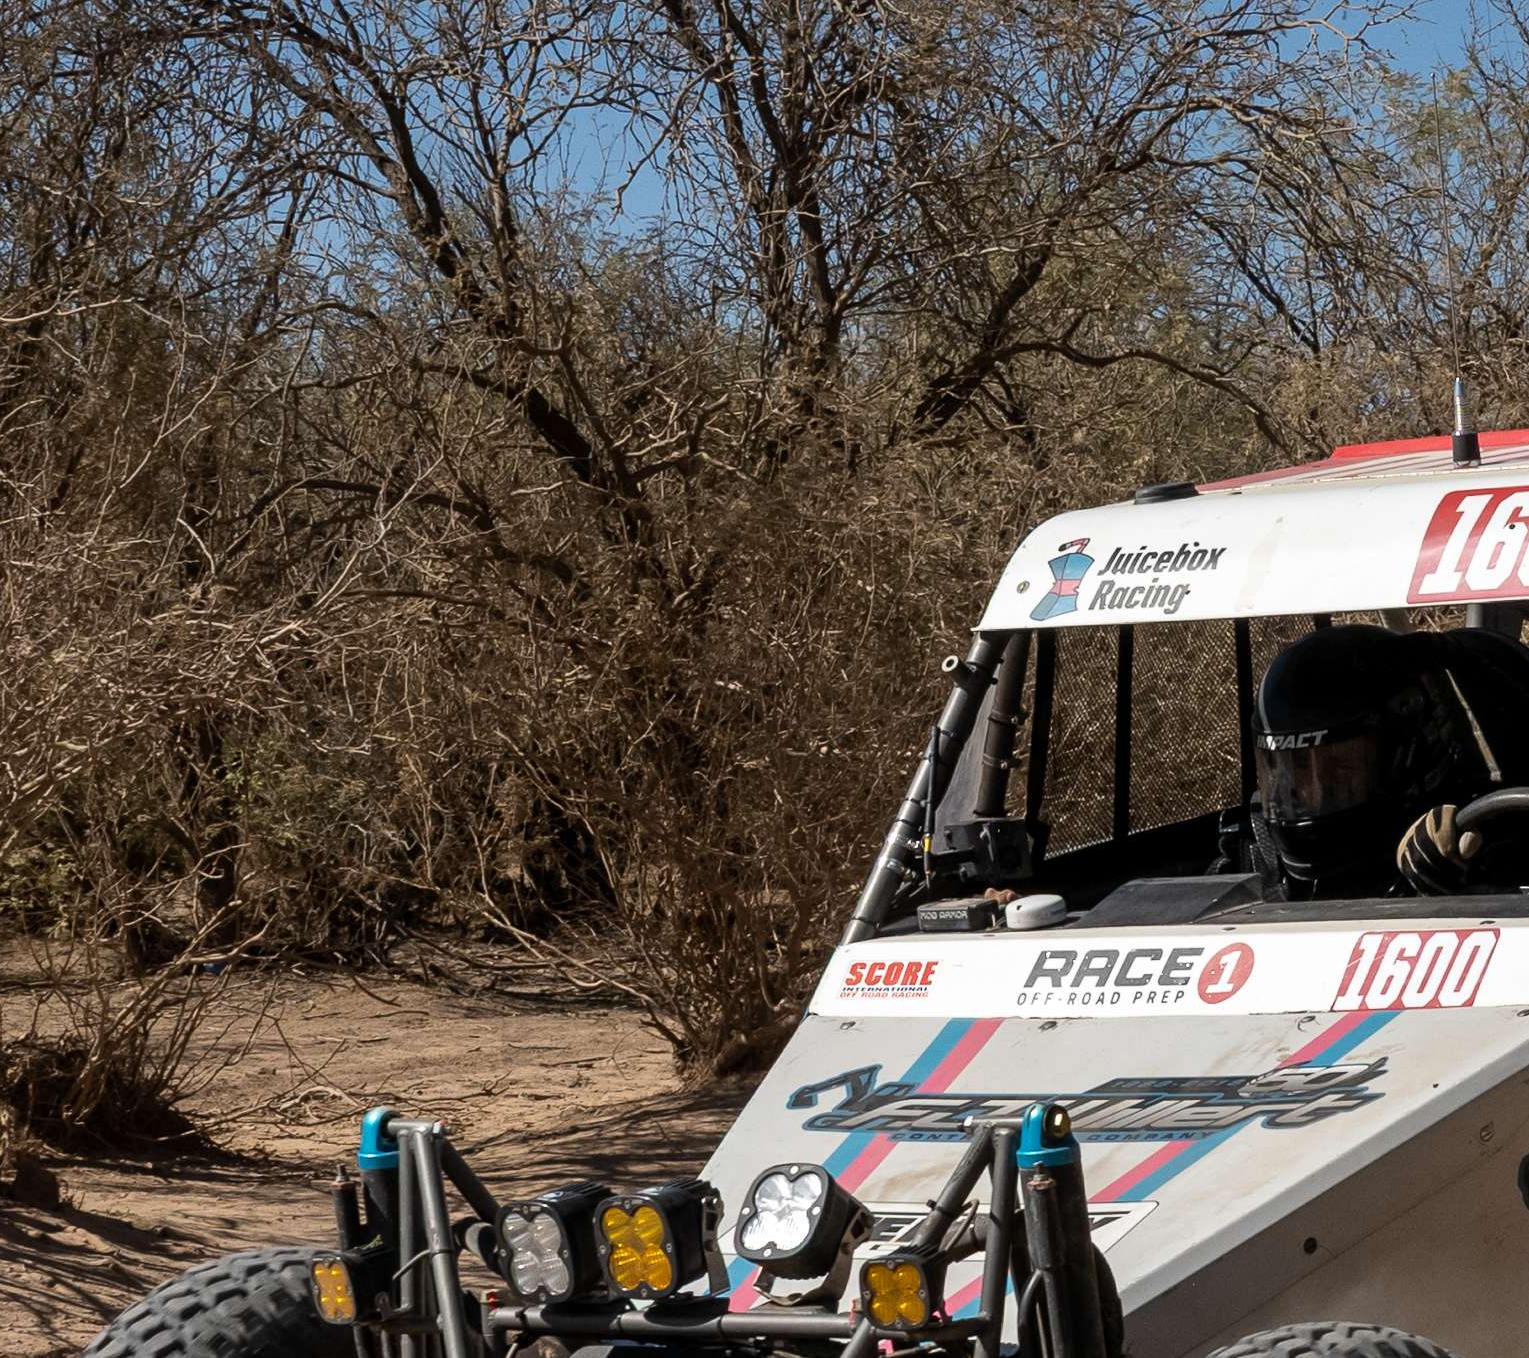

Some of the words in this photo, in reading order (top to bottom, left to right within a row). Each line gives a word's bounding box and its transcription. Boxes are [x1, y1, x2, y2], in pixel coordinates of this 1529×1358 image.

[1097, 543, 1227, 576] Juicebox
[1088, 577, 1190, 615] Racing
[845, 960, 939, 986] SCORE
[1023, 946, 1206, 988] RACE
[1331, 930, 1498, 1012] 1600
[1016, 991, 1122, 1007] OFF-ROAD
[1132, 990, 1186, 1005] PREP
[1086, 1131, 1216, 1142] COMPANY
